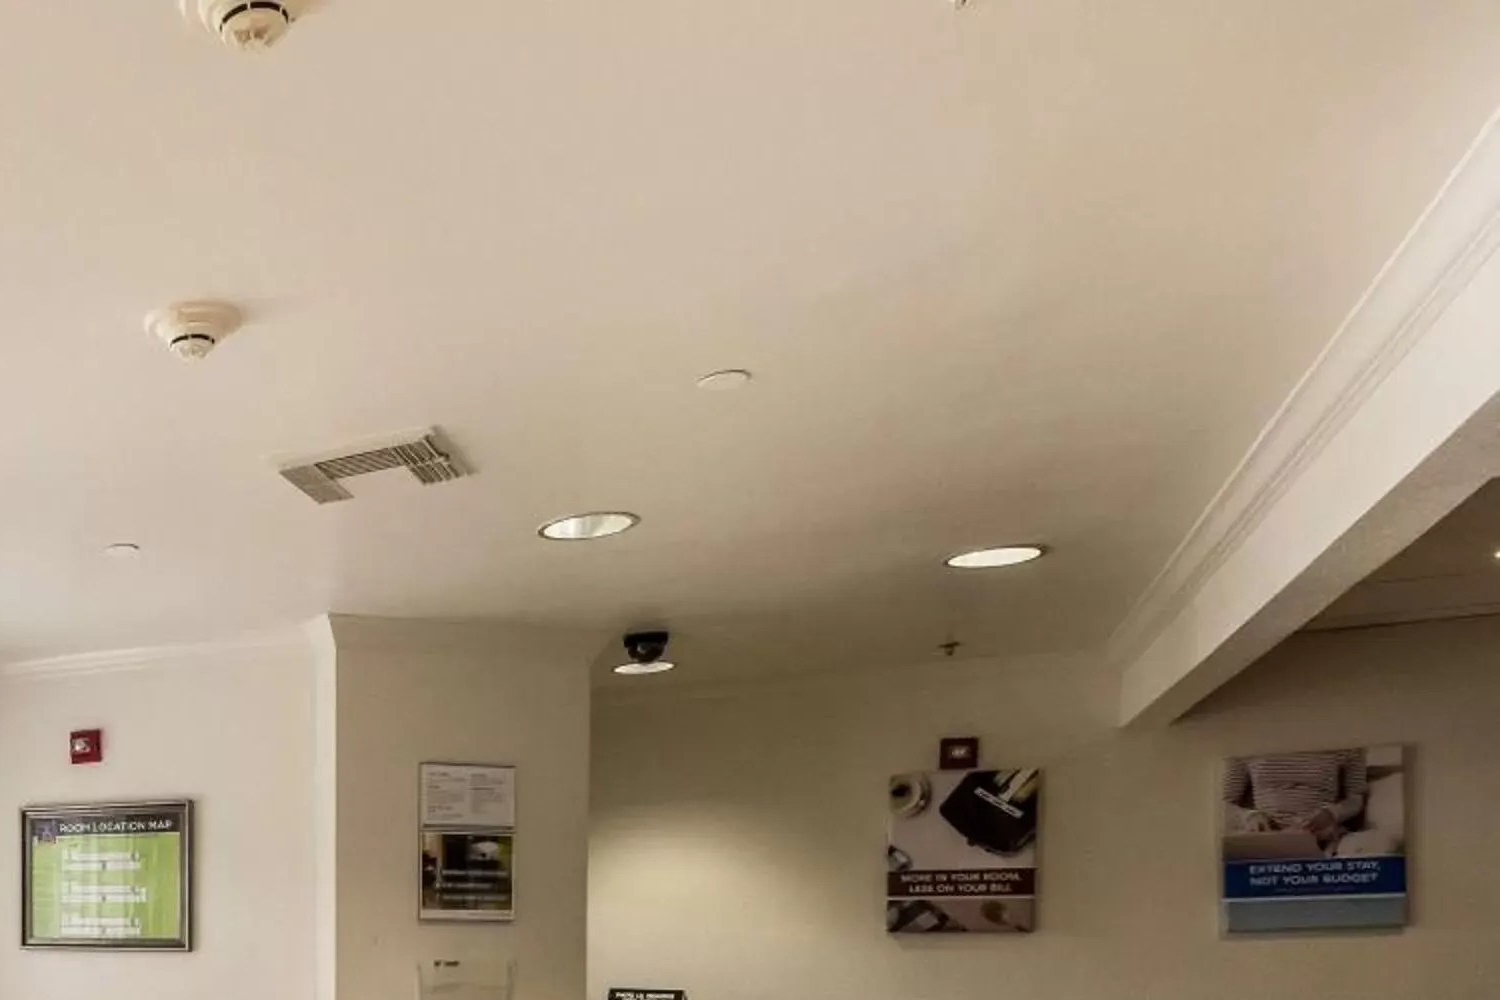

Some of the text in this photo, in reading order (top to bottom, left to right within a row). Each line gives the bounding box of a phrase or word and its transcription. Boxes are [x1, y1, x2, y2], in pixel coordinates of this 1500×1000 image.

[59, 823, 90, 833] ROOM
[148, 819, 173, 830] MAP
[1249, 863, 1302, 874] EXTEND
[1305, 862, 1342, 872] YOUR
[950, 872, 980, 881] YOUR
[1249, 872, 1378, 886] NOT YOUR BUDGET
[935, 883, 954, 893] ON
[957, 883, 987, 893] YOUR
